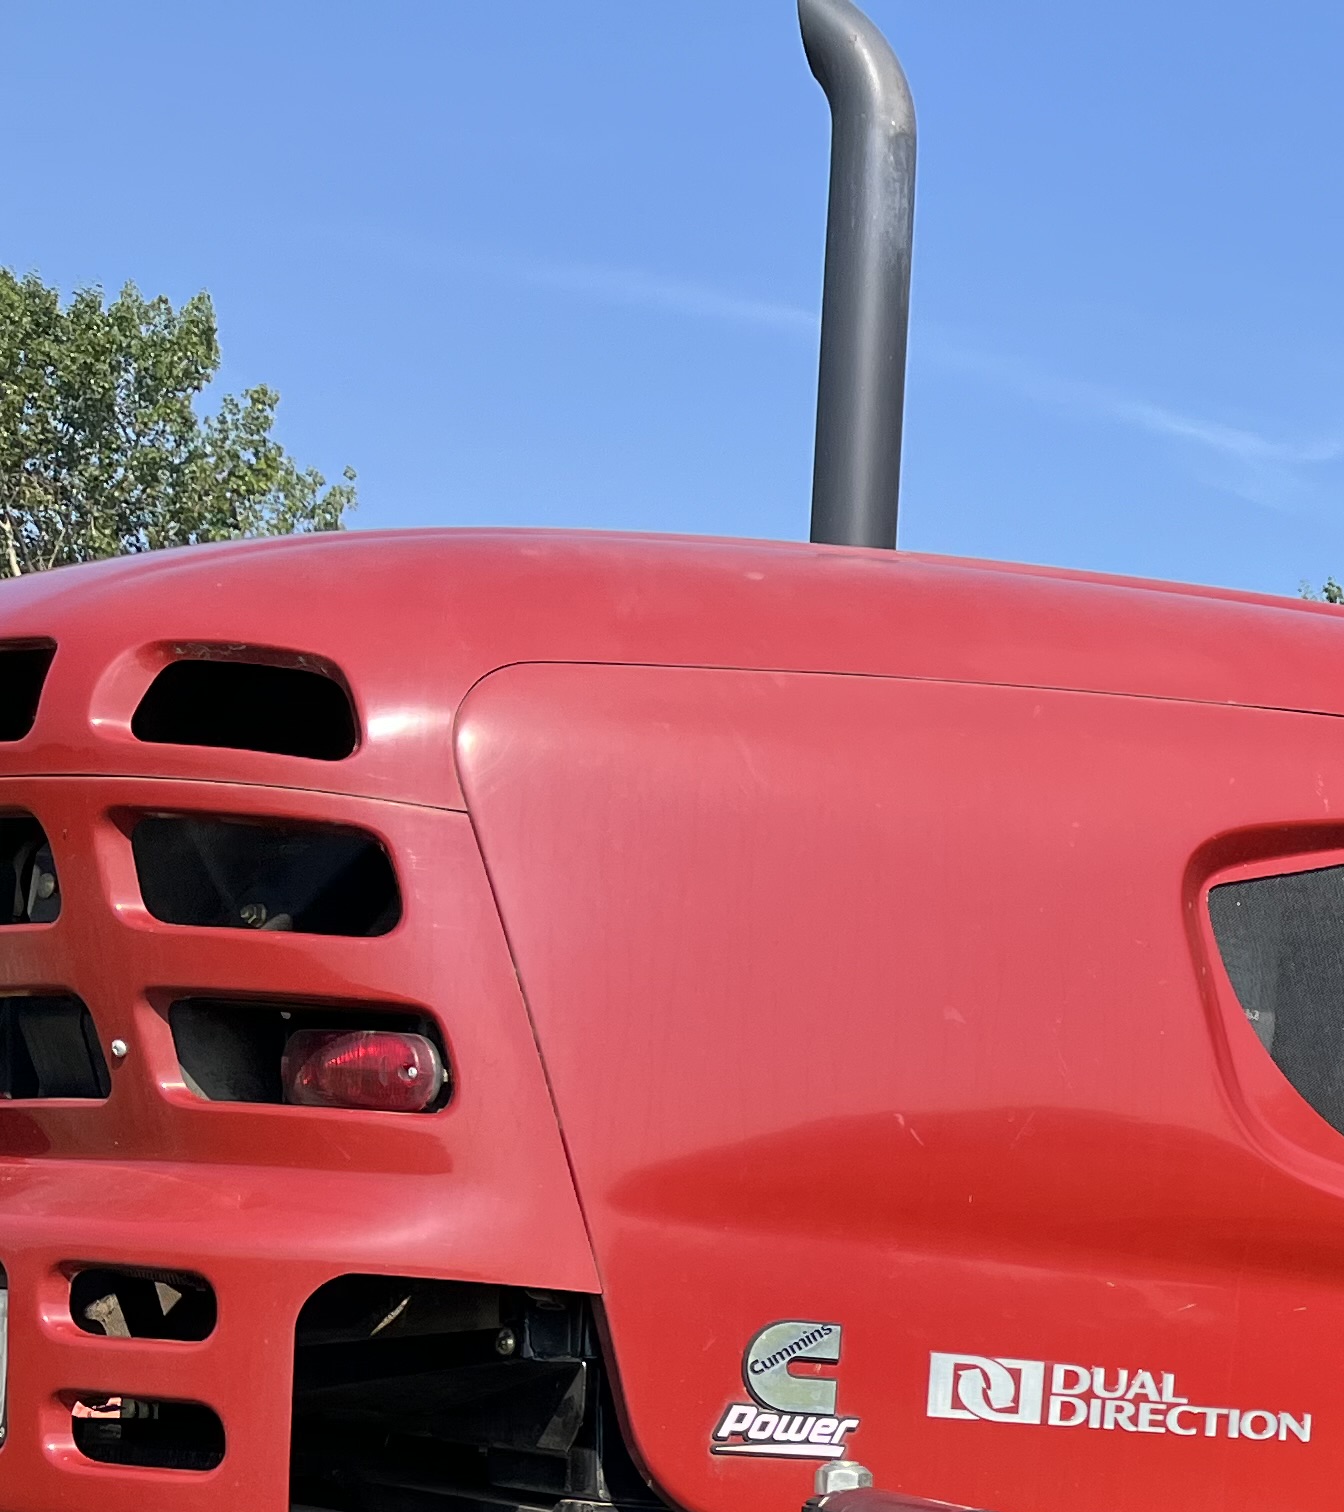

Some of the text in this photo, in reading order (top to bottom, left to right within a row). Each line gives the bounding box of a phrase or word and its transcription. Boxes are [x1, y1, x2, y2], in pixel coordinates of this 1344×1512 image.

[750, 1325, 833, 1375] Cummins
[1051, 1363, 1189, 1405] DUAL
[716, 1404, 860, 1444] Power
[1047, 1395, 1312, 1443] DIRECTION
